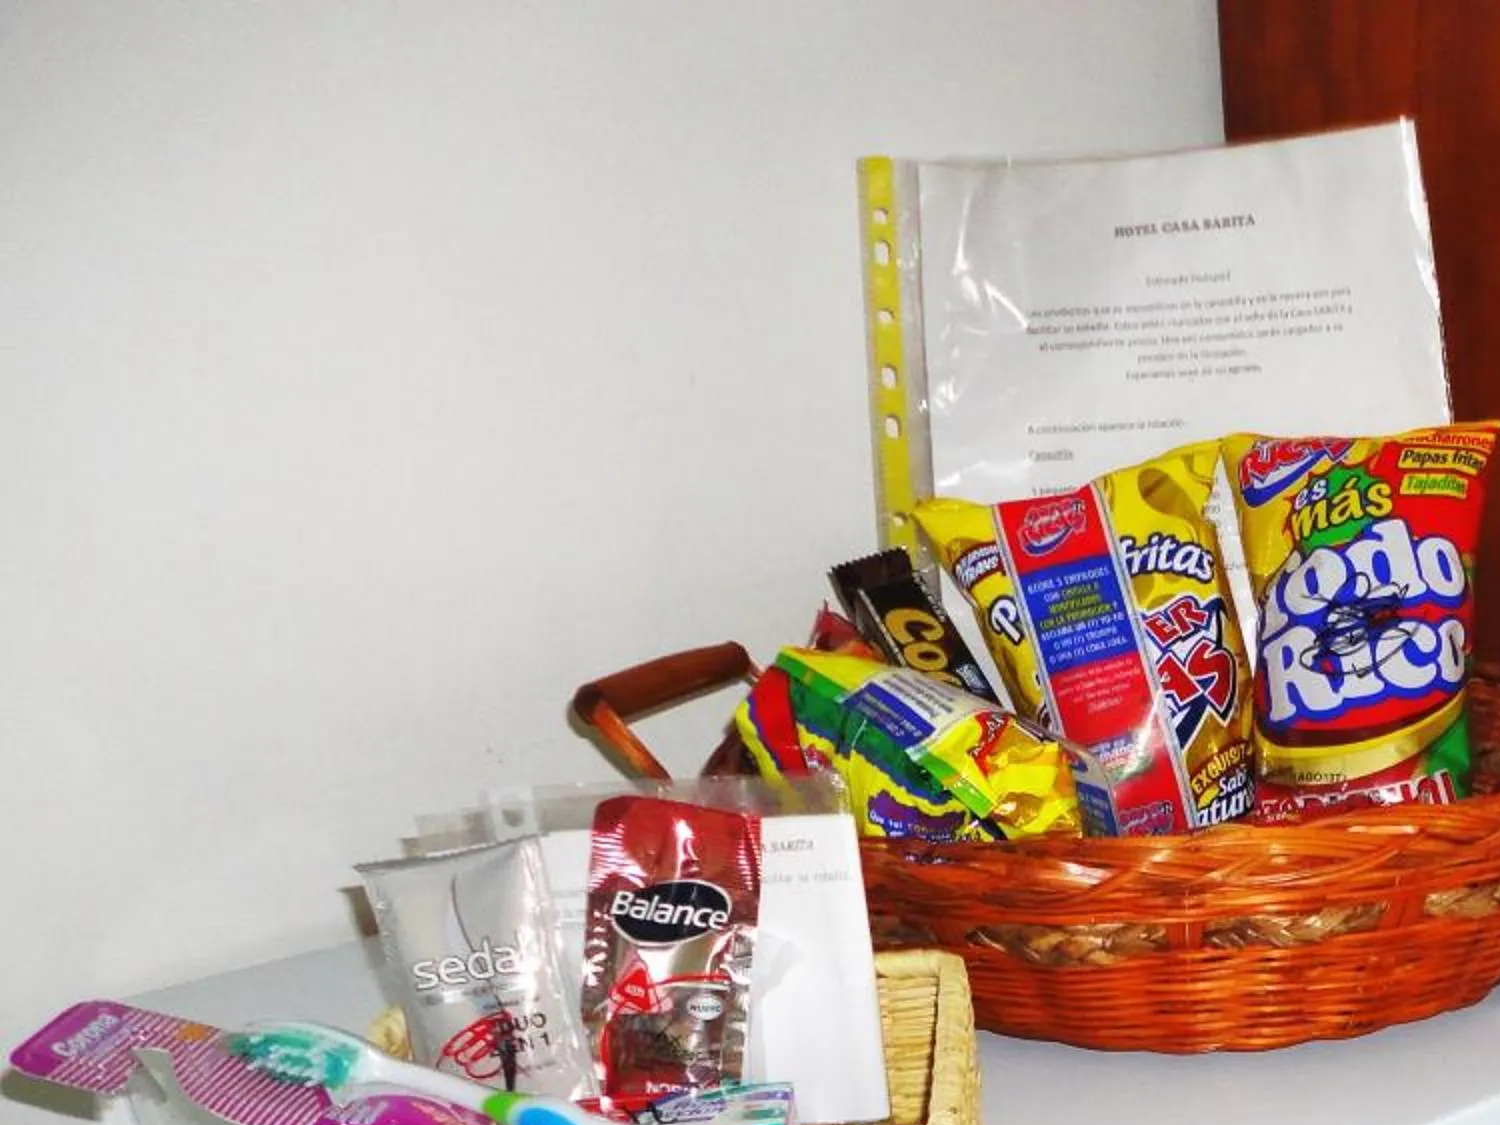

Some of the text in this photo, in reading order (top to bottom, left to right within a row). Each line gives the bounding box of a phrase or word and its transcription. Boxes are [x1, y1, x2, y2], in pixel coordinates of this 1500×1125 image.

[1114, 214, 1256, 239] HOTEL CASA SARITA
[1402, 448, 1448, 467] Papas
[1292, 476, 1394, 543] más
[1120, 534, 1215, 583] fritas
[1262, 619, 1467, 724] Rico
[610, 890, 729, 931] Balance
[414, 934, 522, 992] seda
